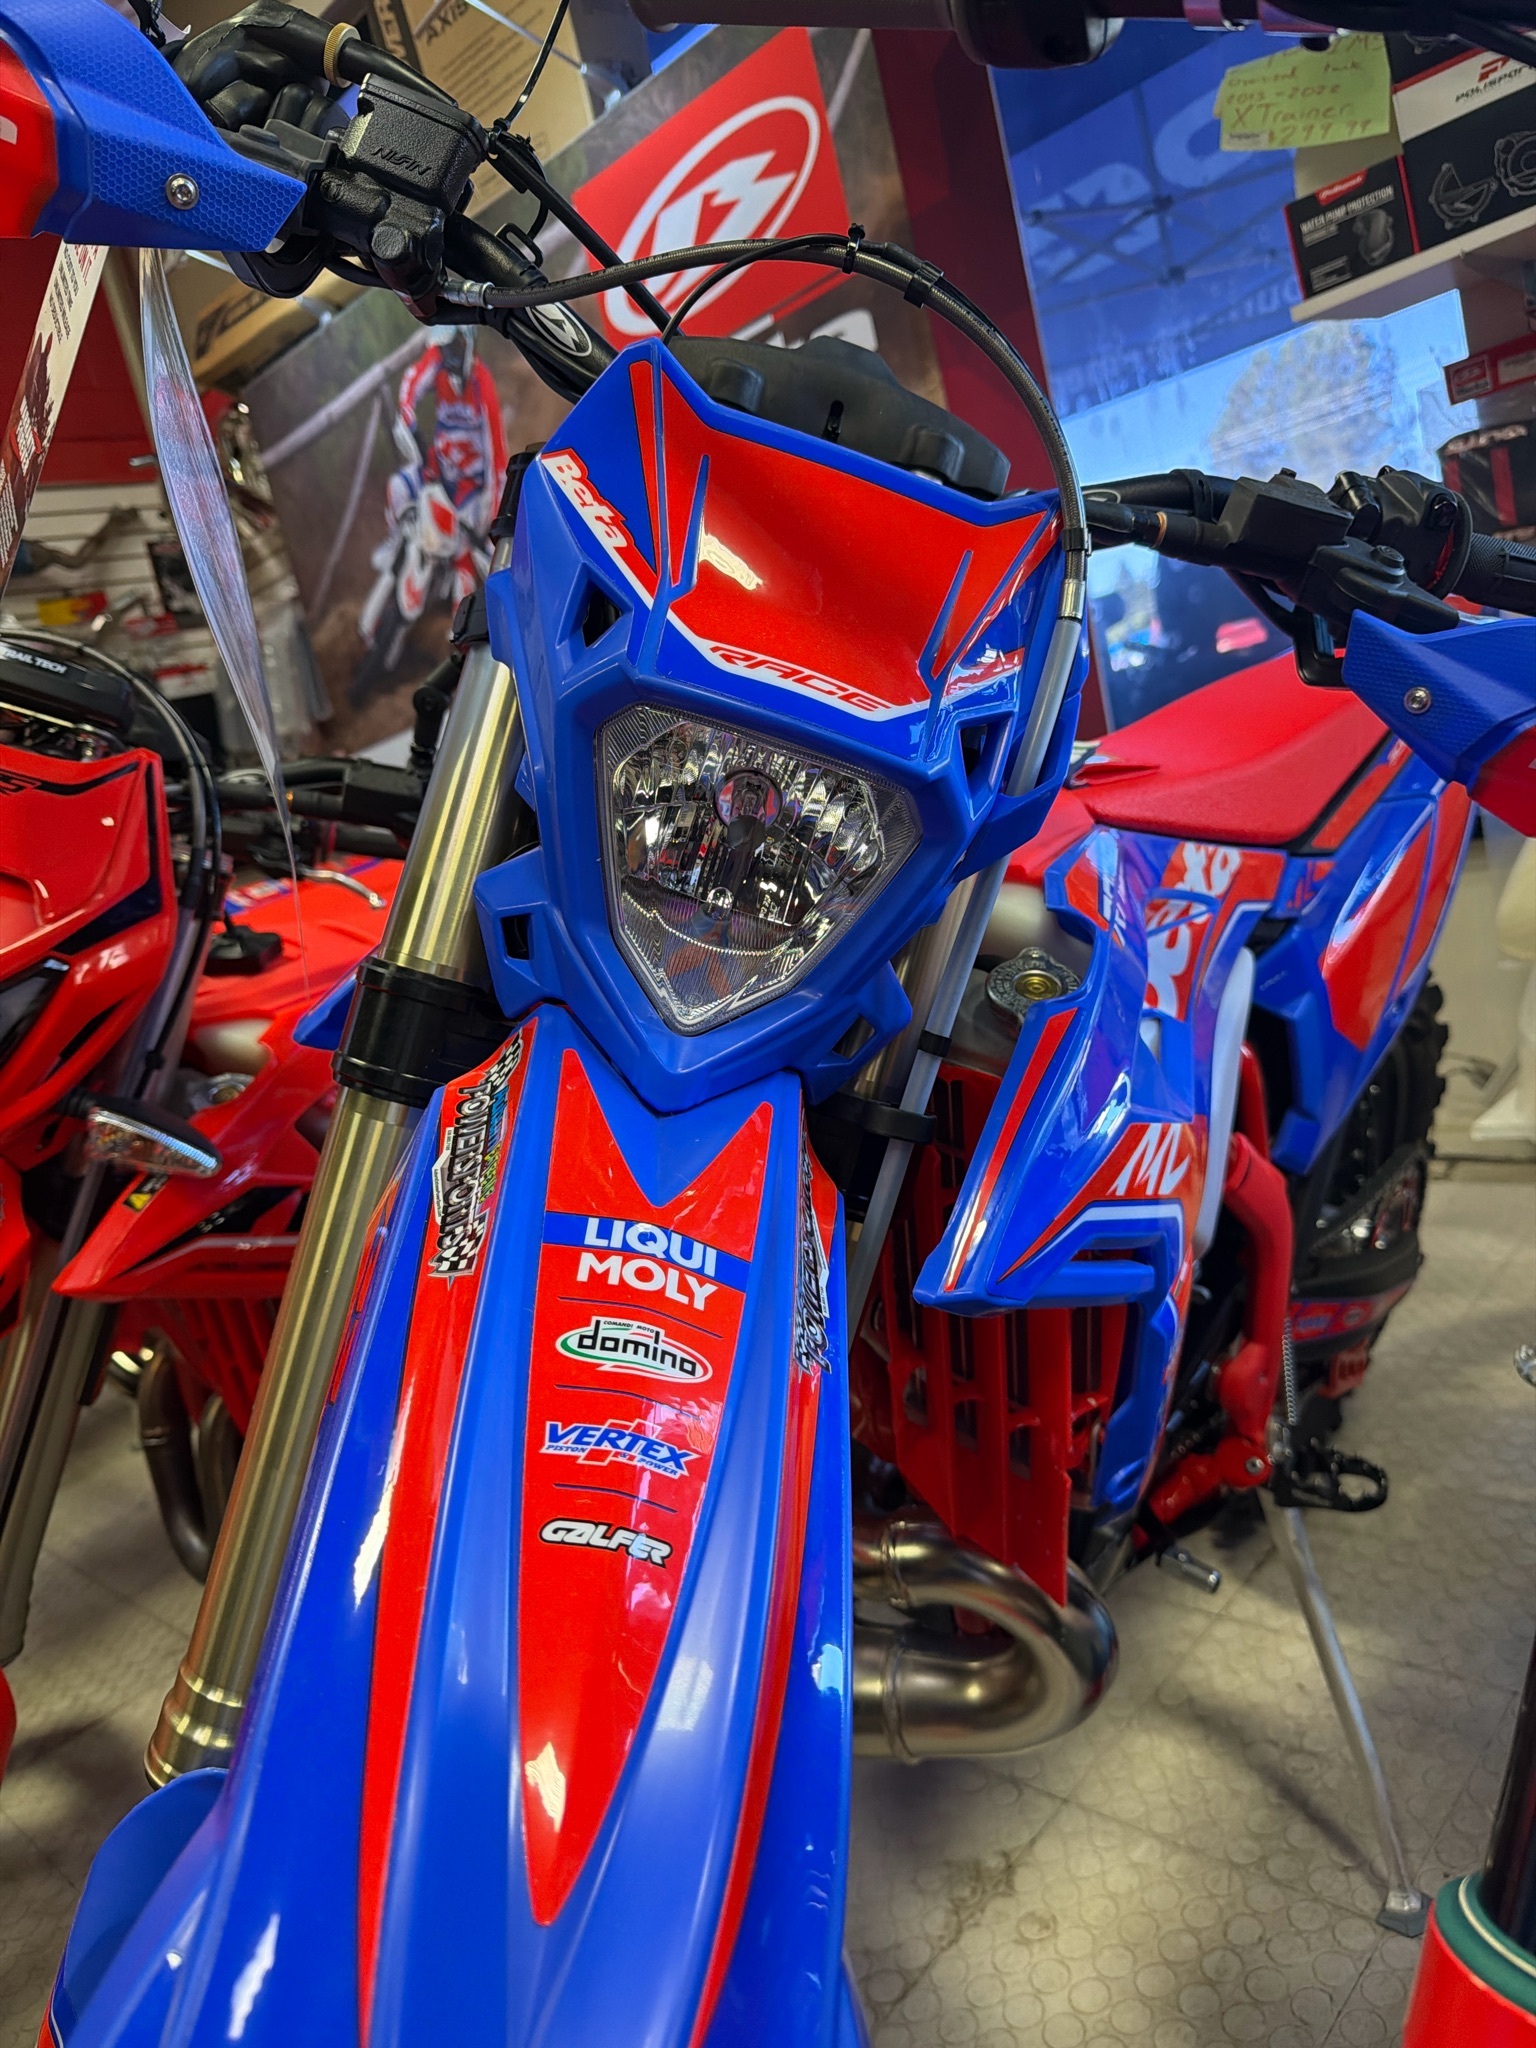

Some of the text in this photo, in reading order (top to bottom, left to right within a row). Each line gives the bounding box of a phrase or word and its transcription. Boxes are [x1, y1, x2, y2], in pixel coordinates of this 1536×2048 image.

[541, 454, 628, 549] Beta
[709, 646, 893, 712] RACE
[436, 1082, 493, 1250] POWERSPORTS
[584, 1217, 718, 1277] LIQUI
[576, 1251, 719, 1311] MOLY
[577, 1319, 697, 1377] domino
[603, 1320, 655, 1334] COMANDI MOTO
[545, 1445, 589, 1453] PISTON
[637, 1457, 679, 1476] POWER
[548, 1423, 694, 1472] VERTEX
[541, 1519, 672, 1566] GALFER
